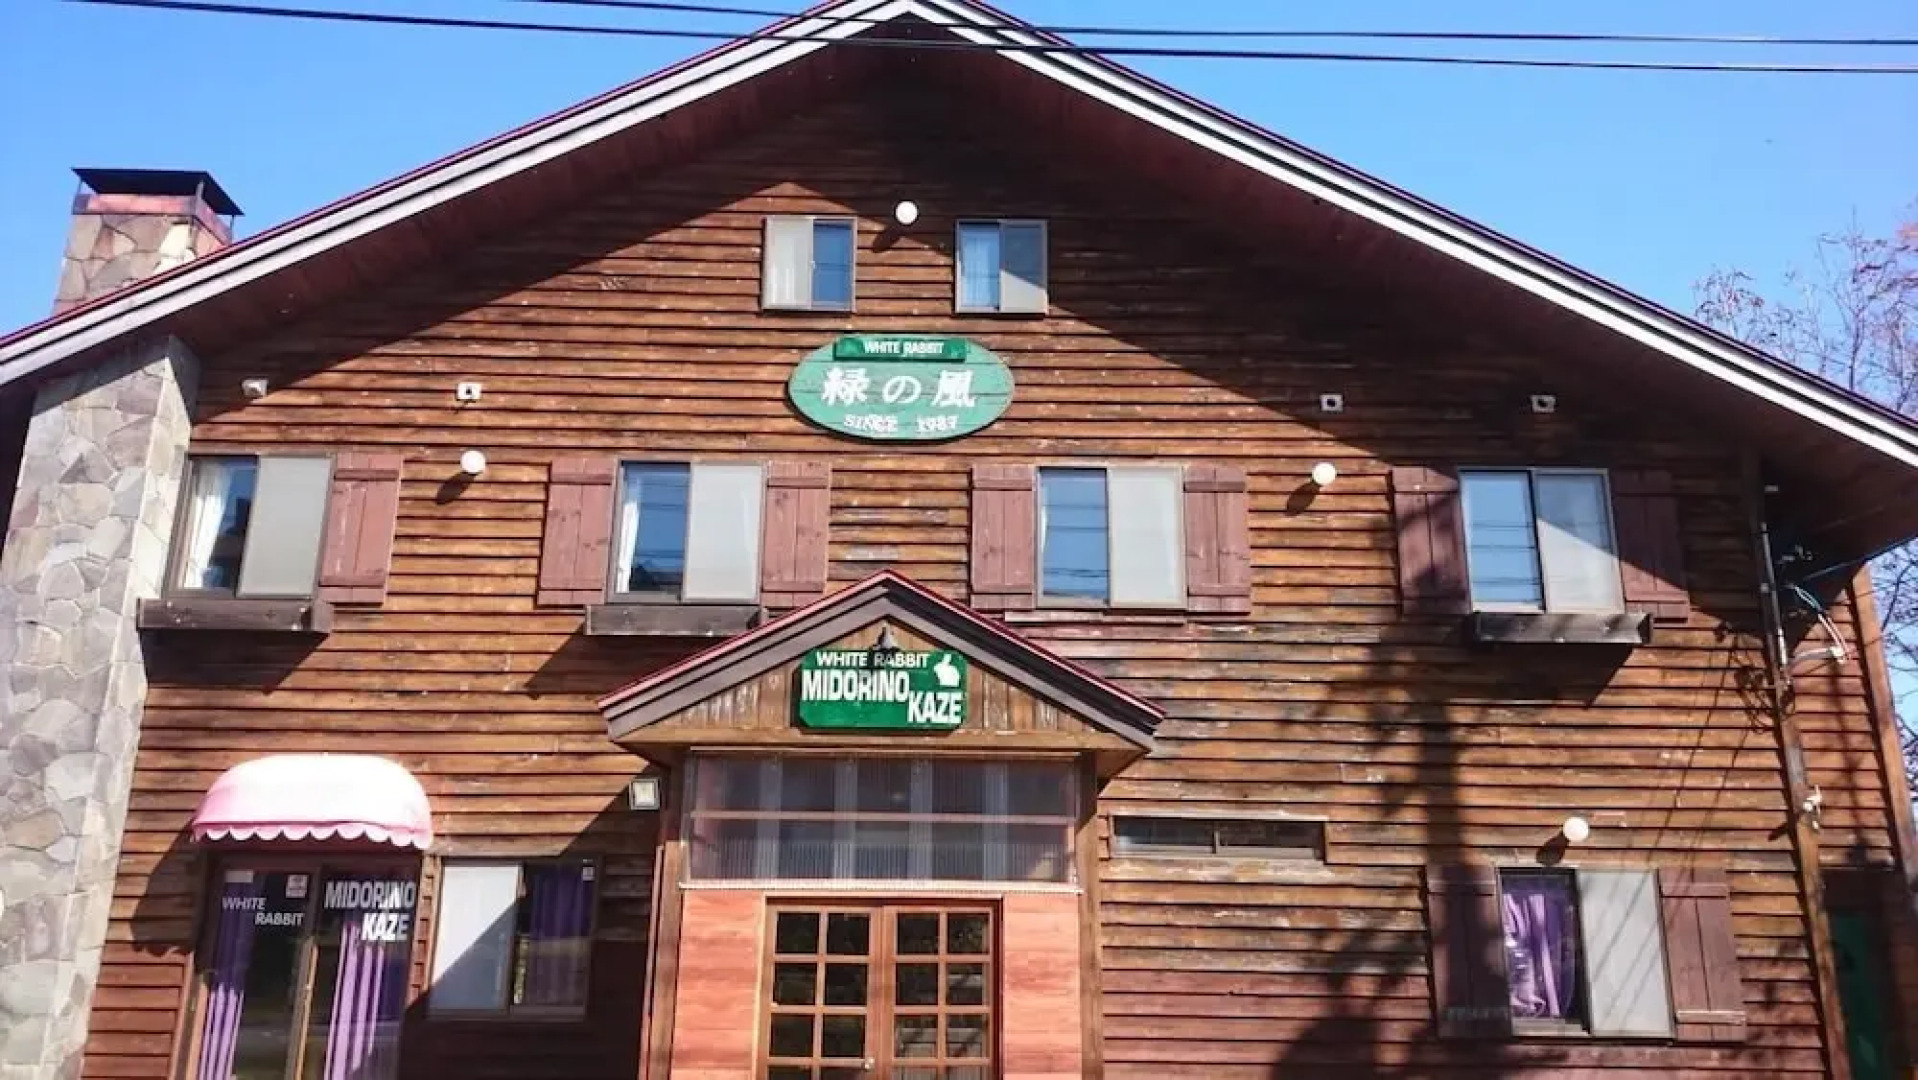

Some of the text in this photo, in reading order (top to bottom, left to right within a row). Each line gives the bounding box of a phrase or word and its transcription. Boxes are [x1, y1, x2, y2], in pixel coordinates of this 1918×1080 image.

[864, 341, 900, 354] WHITE
[822, 367, 975, 407] 緑の風
[816, 651, 929, 667] WHITE RABBIT
[802, 669, 909, 701] MIDORINO
[907, 691, 962, 724] KAZE
[222, 897, 267, 910] WHITE
[324, 881, 416, 908] MIDORINO
[255, 912, 304, 926] RABBIT
[361, 913, 410, 941] KAZE
